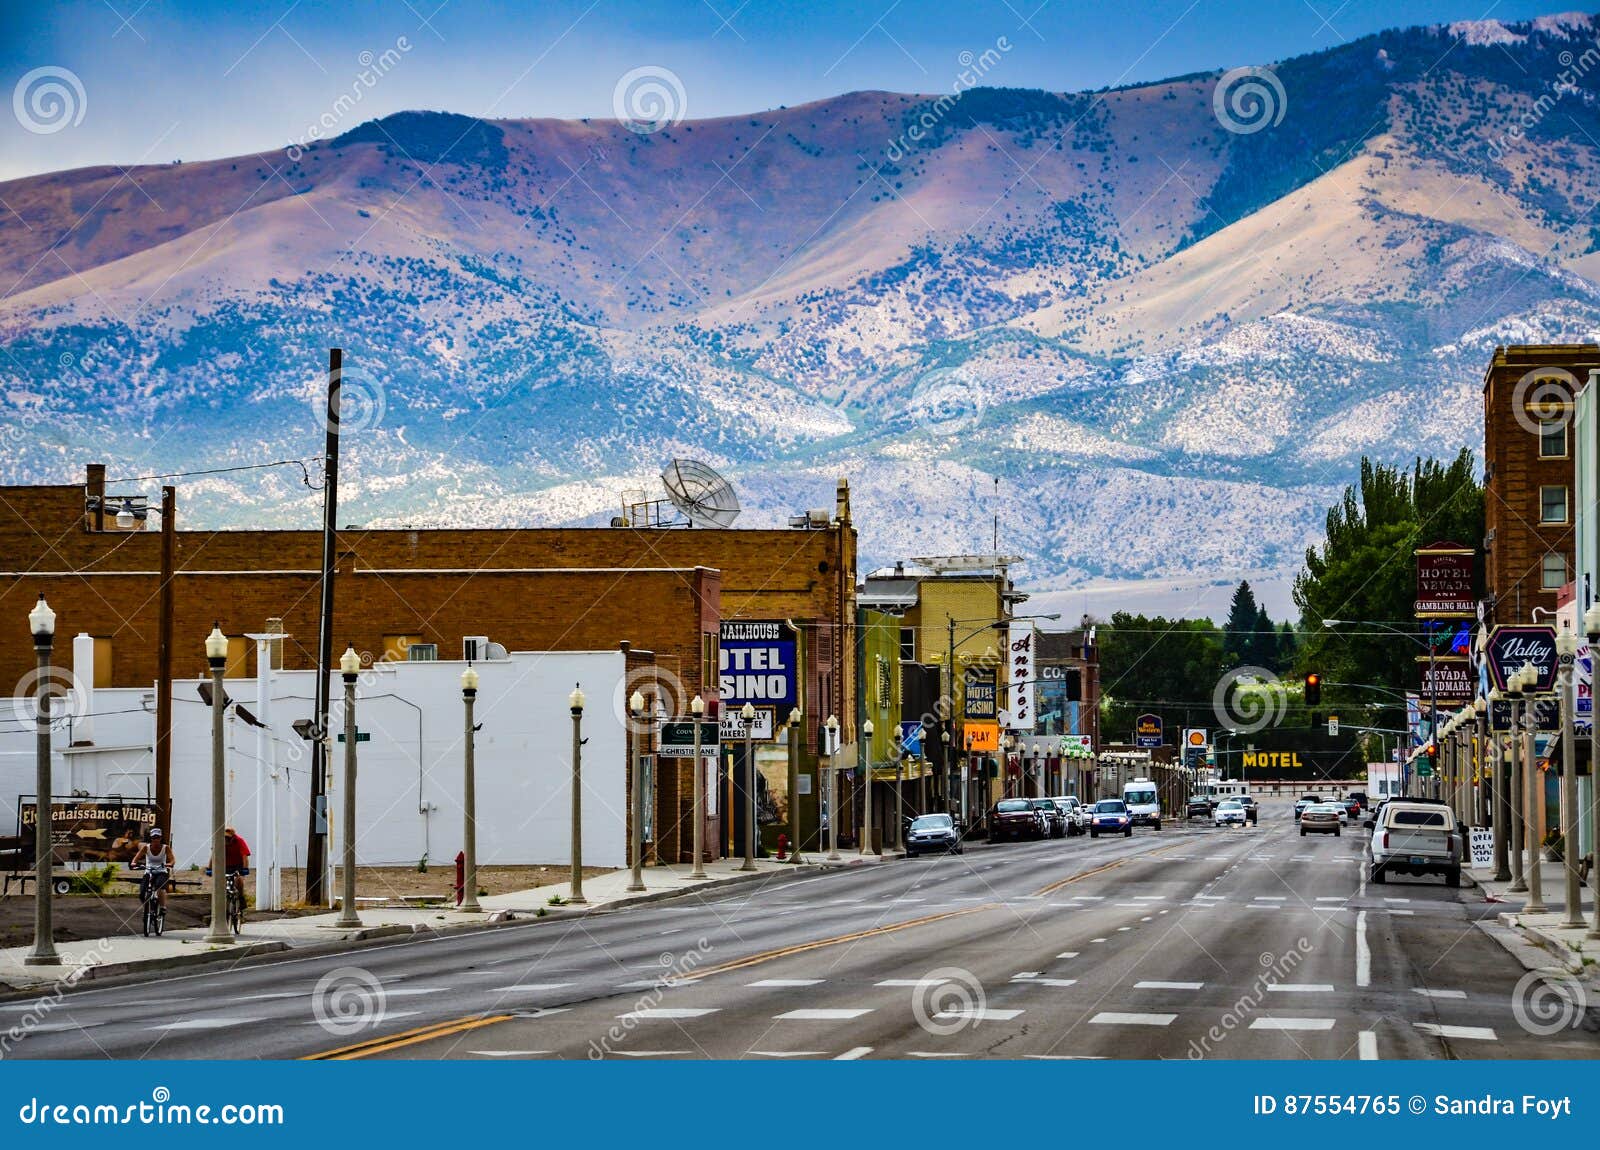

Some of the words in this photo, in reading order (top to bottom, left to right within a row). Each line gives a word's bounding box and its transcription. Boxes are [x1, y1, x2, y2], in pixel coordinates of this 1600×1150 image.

[1420, 568, 1471, 578] HOTEL
[1421, 581, 1471, 590] NEVADA
[1416, 602, 1455, 610] GAMBLING
[1456, 602, 1475, 610] HALL
[722, 623, 780, 640] JAILHOUSE
[1502, 637, 1551, 665] Valley
[1425, 671, 1468, 681] NEVADA
[720, 675, 787, 700] SINO
[1421, 681, 1472, 691] LANDMARK
[966, 686, 993, 699] MOTEL
[966, 701, 994, 714] CASINO
[971, 731, 990, 742] PLAY
[1242, 752, 1303, 768] MOTEL
[51, 806, 119, 821] enaissance
[122, 807, 157, 827] Villag
[1473, 833, 1492, 842] OPEN
